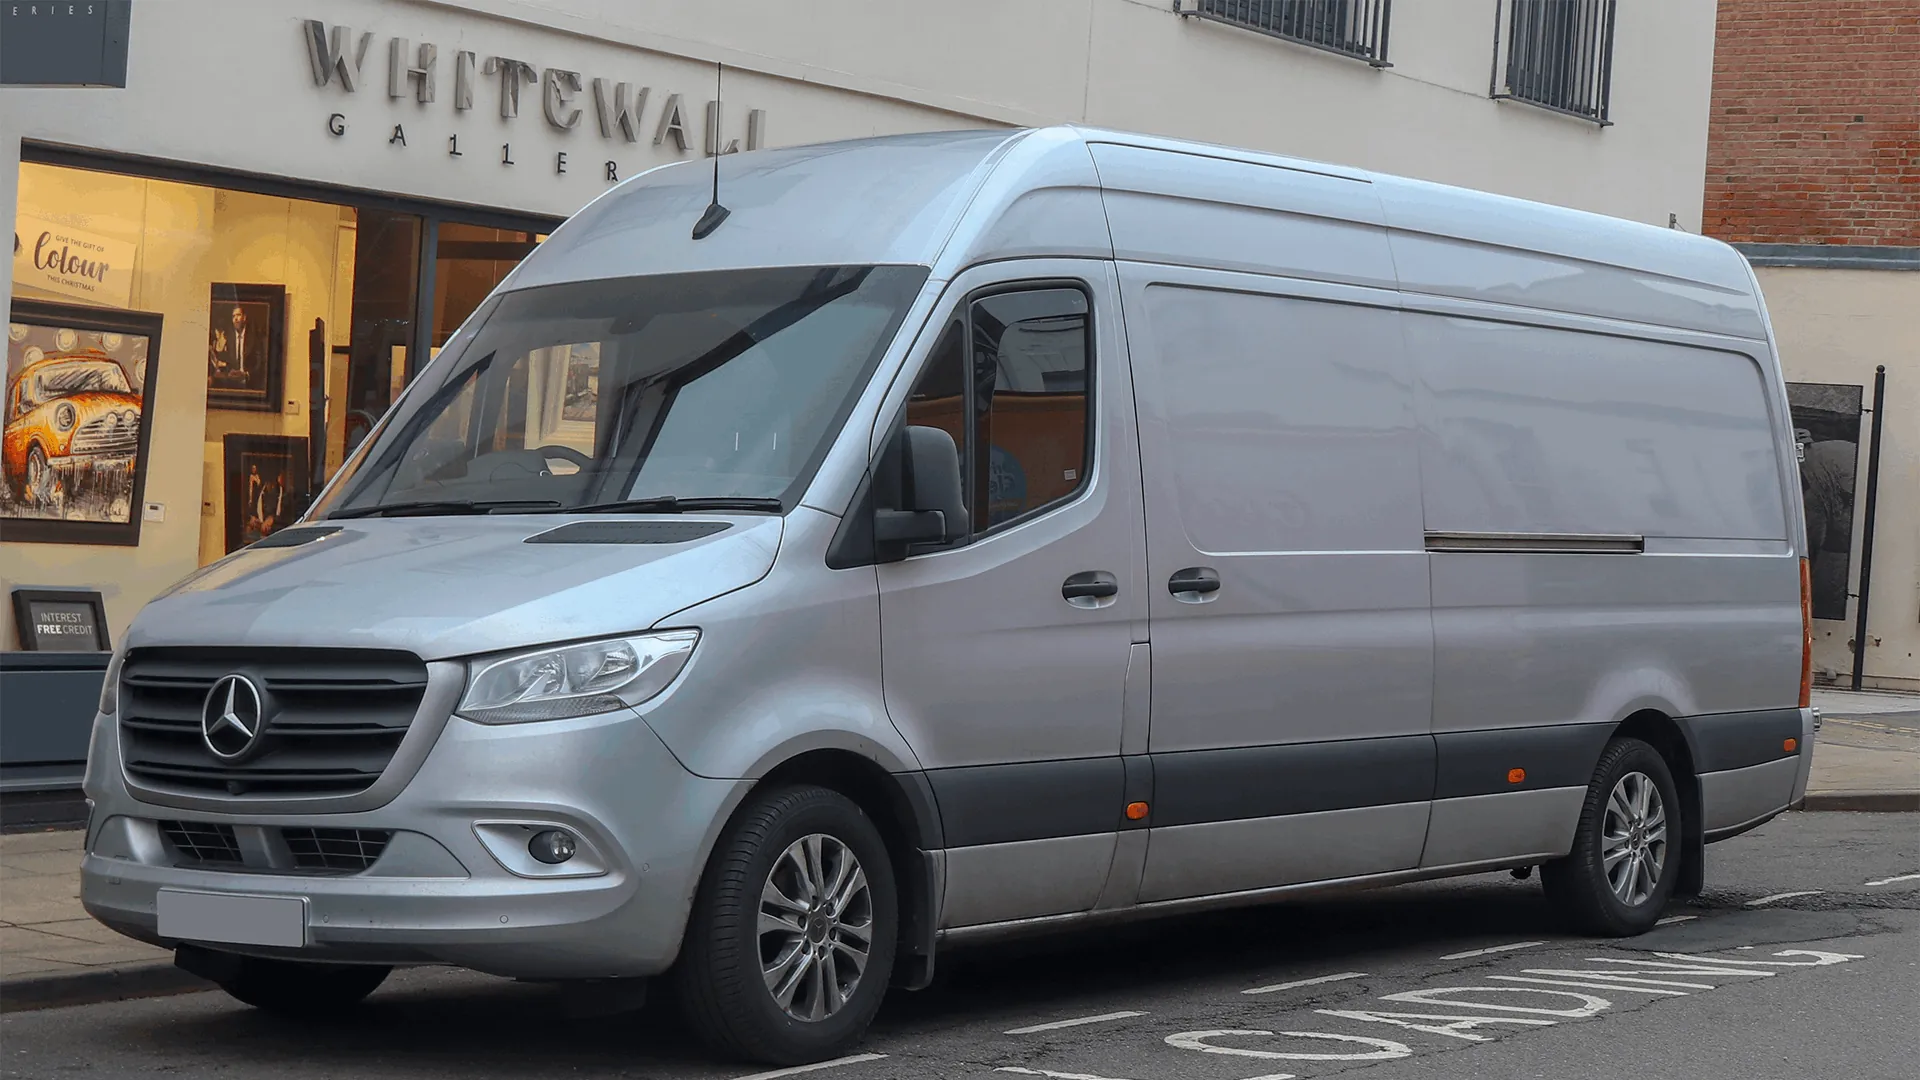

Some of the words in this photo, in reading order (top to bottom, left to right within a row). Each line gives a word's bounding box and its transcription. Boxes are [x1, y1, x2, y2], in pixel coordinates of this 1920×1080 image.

[12, 5, 93, 16] ERIES
[328, 113, 619, 182] GALLER
[56, 235, 69, 244] GIVE
[70, 238, 81, 247] THE
[83, 242, 96, 251] GIFT
[34, 231, 109, 283] Colour
[47, 274, 60, 284] THIS
[61, 278, 95, 292] CHRISTMAS
[41, 612, 81, 622] INTEREST
[37, 624, 62, 635] FREE
[62, 625, 93, 635] CREDIT
